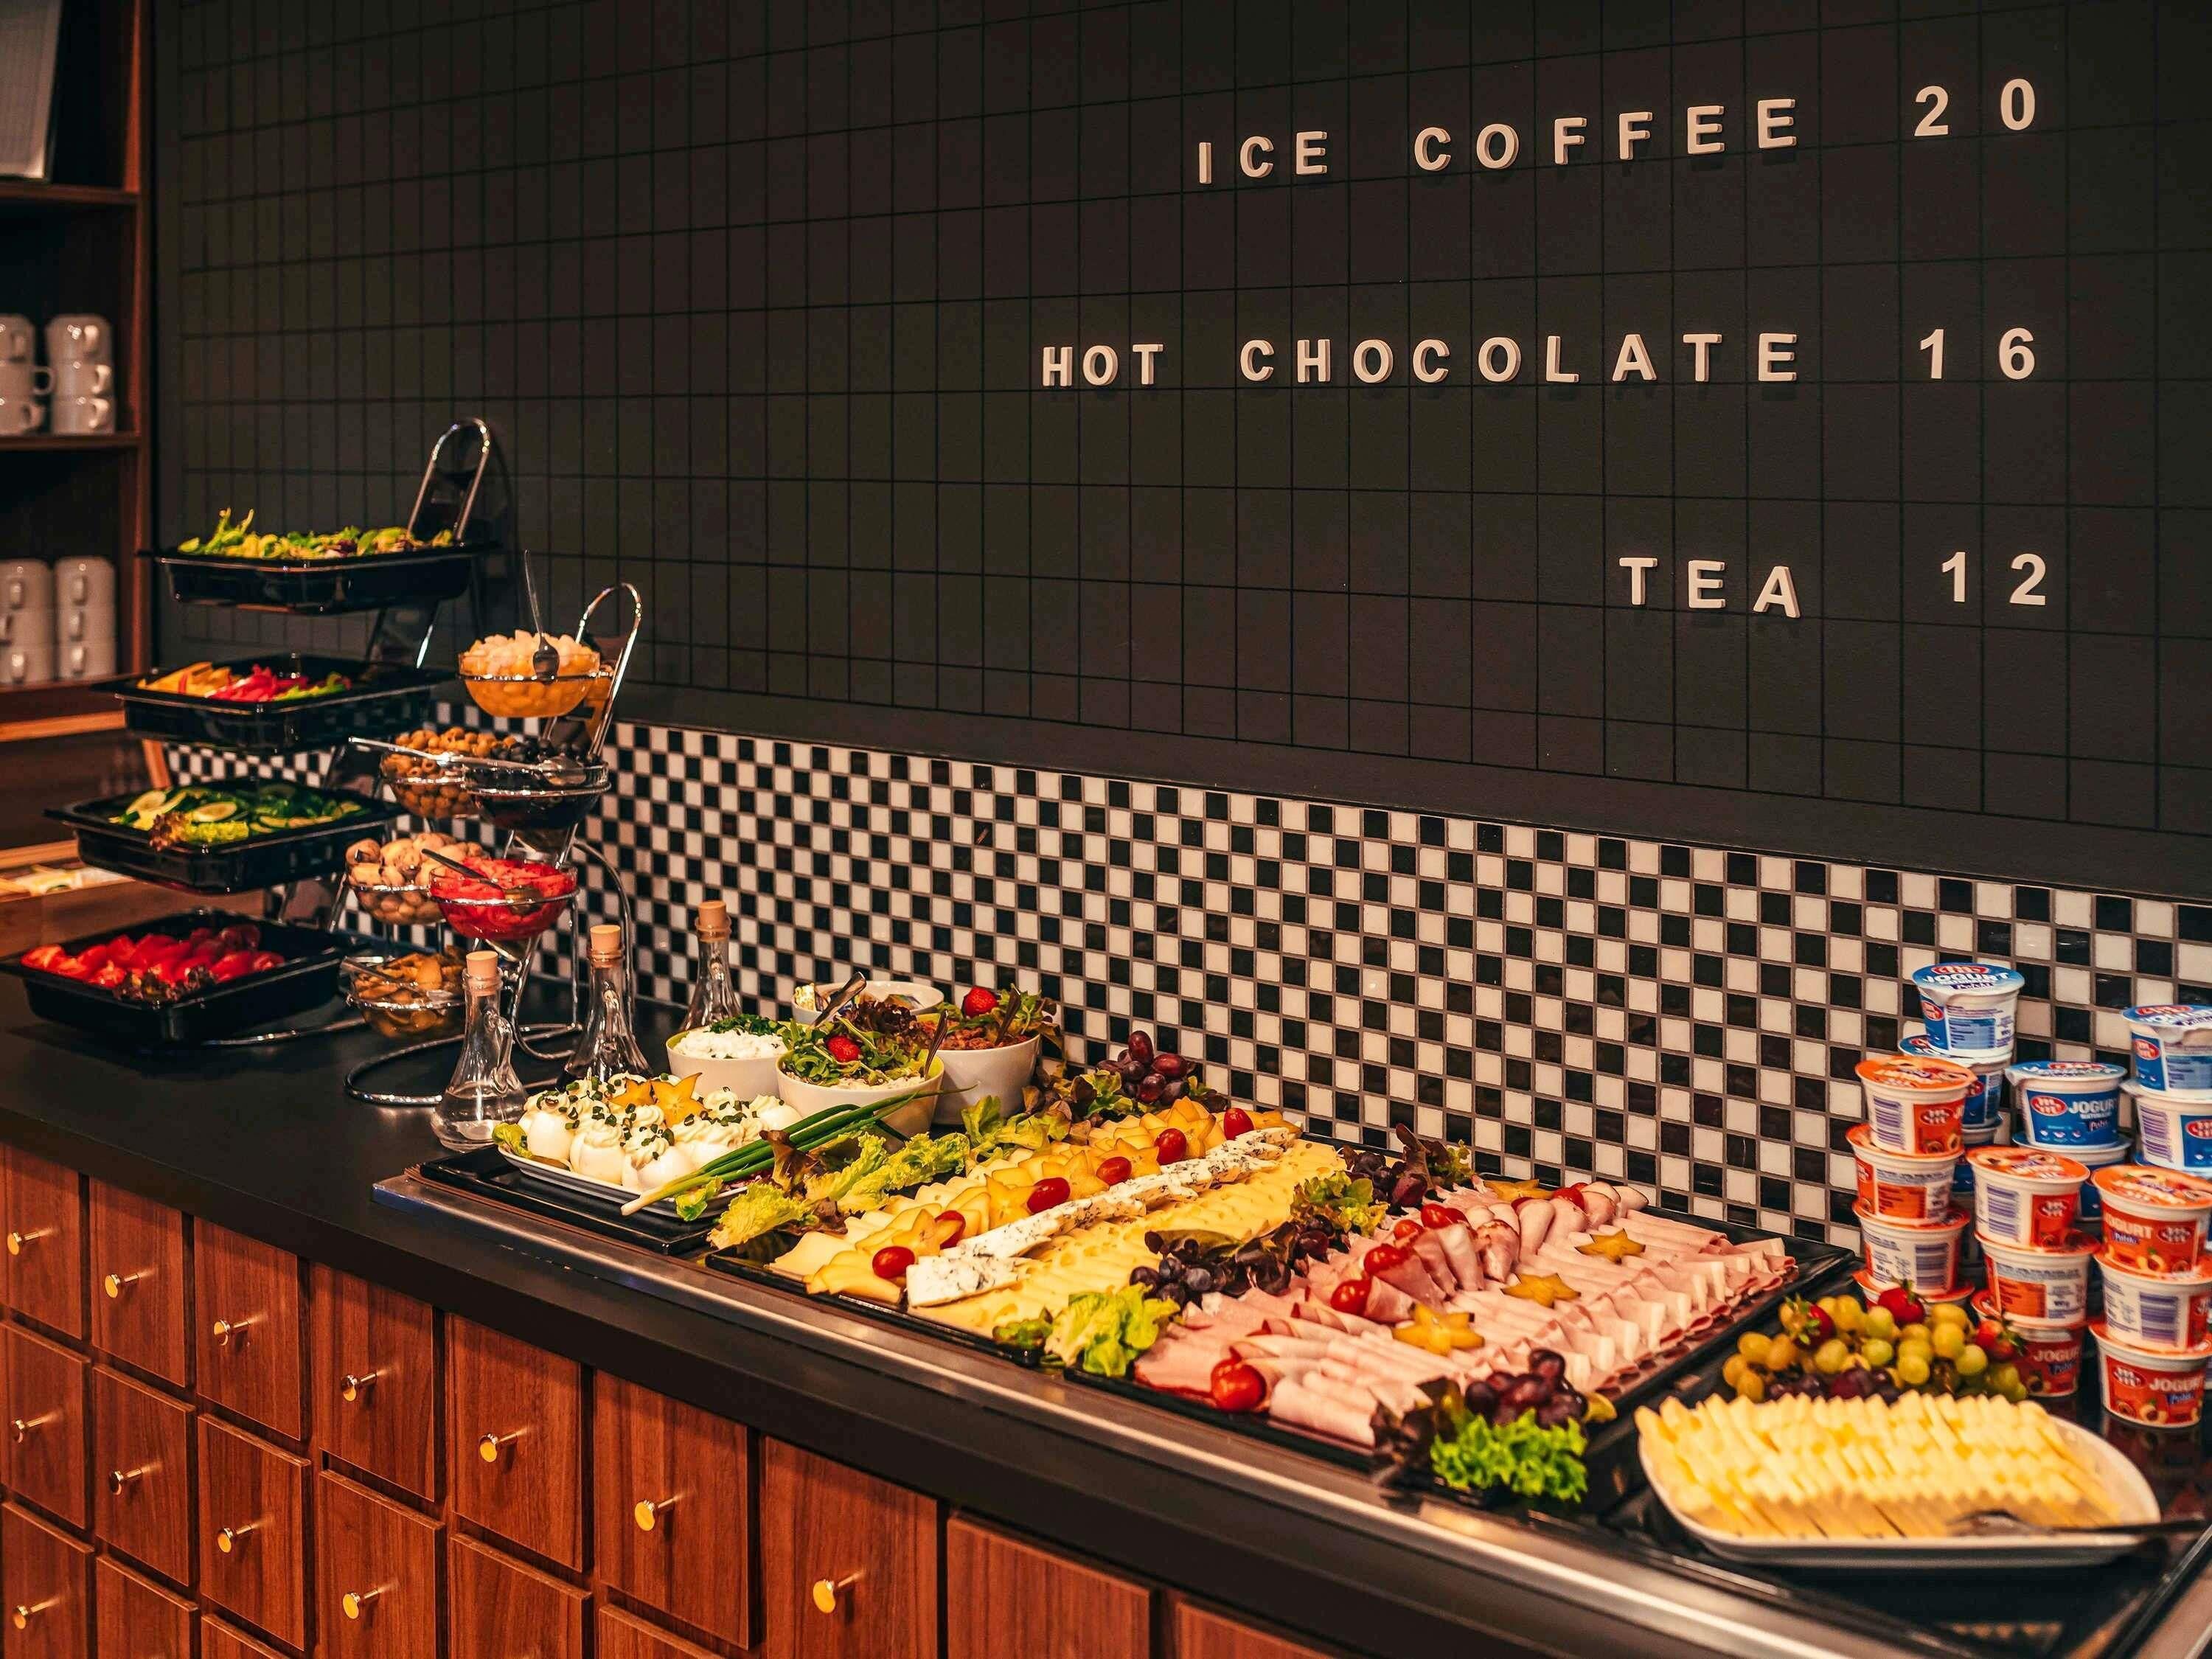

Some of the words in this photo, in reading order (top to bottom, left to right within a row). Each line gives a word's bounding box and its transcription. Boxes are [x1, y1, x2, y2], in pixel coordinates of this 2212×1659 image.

[1197, 131, 1329, 185] ICE
[1413, 98, 1798, 172] COFFEE
[1913, 78, 2037, 138] 20
[1041, 344, 1164, 388] HOT
[1239, 333, 1798, 383] CHOCOLATE
[1919, 327, 2036, 381] 16
[1618, 556, 1801, 619] TEA
[1941, 551, 2047, 606] 12
[1922, 972, 2009, 984] JOGURT
